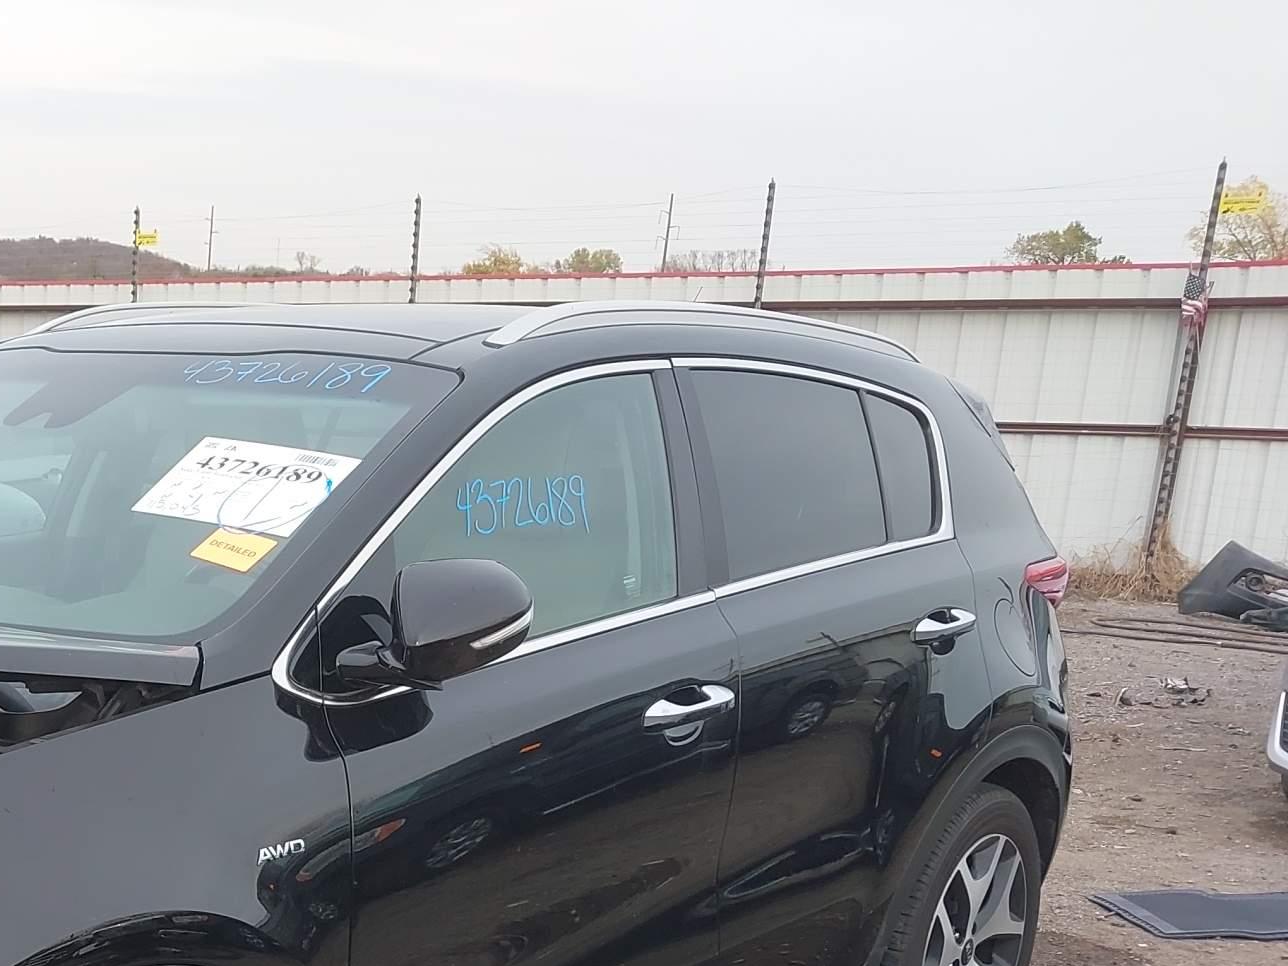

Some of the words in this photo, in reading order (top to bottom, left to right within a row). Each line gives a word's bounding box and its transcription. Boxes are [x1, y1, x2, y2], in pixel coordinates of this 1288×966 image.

[183, 359, 392, 393] 43726189
[195, 455, 323, 484] 43726189
[456, 474, 591, 537] 43726189
[257, 838, 305, 866] AWD
